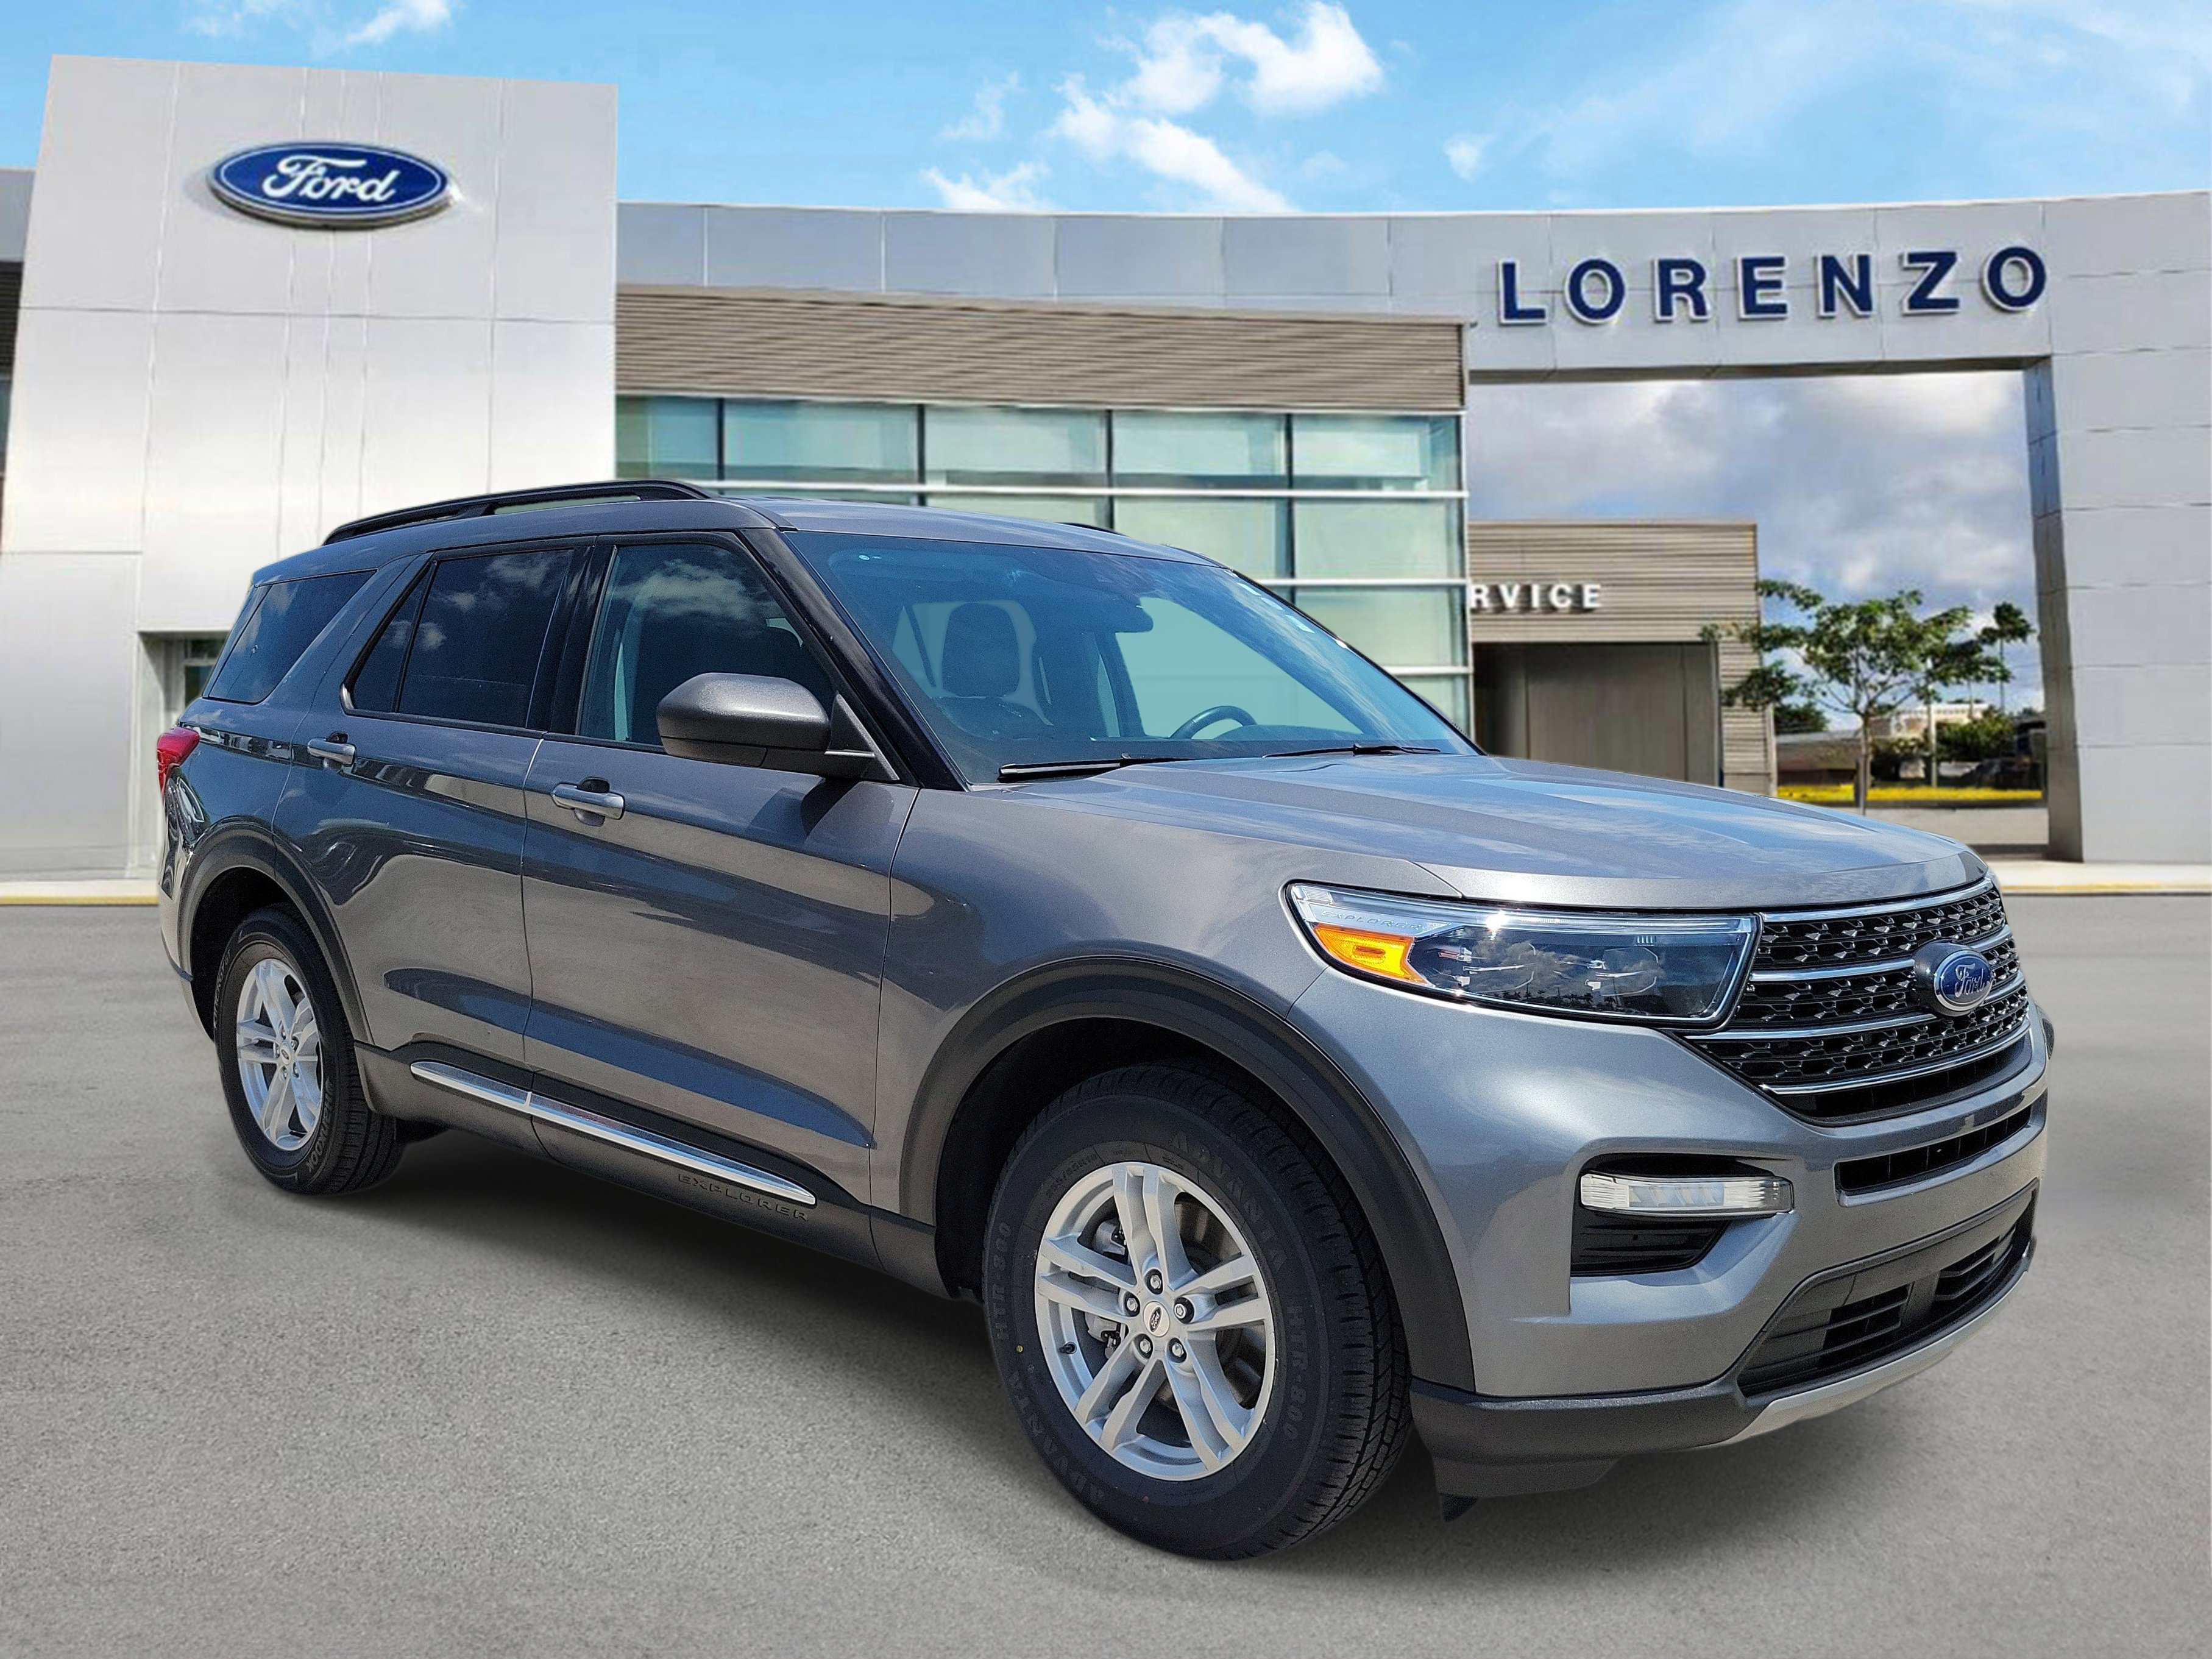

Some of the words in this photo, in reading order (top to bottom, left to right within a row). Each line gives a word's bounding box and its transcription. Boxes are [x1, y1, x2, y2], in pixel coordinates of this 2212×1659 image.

[263, 154, 400, 202] Ford
[1498, 247, 2047, 324] LORENZO
[1320, 911, 1422, 931] EXPLORER
[1954, 963, 1985, 998] Ford
[678, 1173, 809, 1222] EXPLORER
